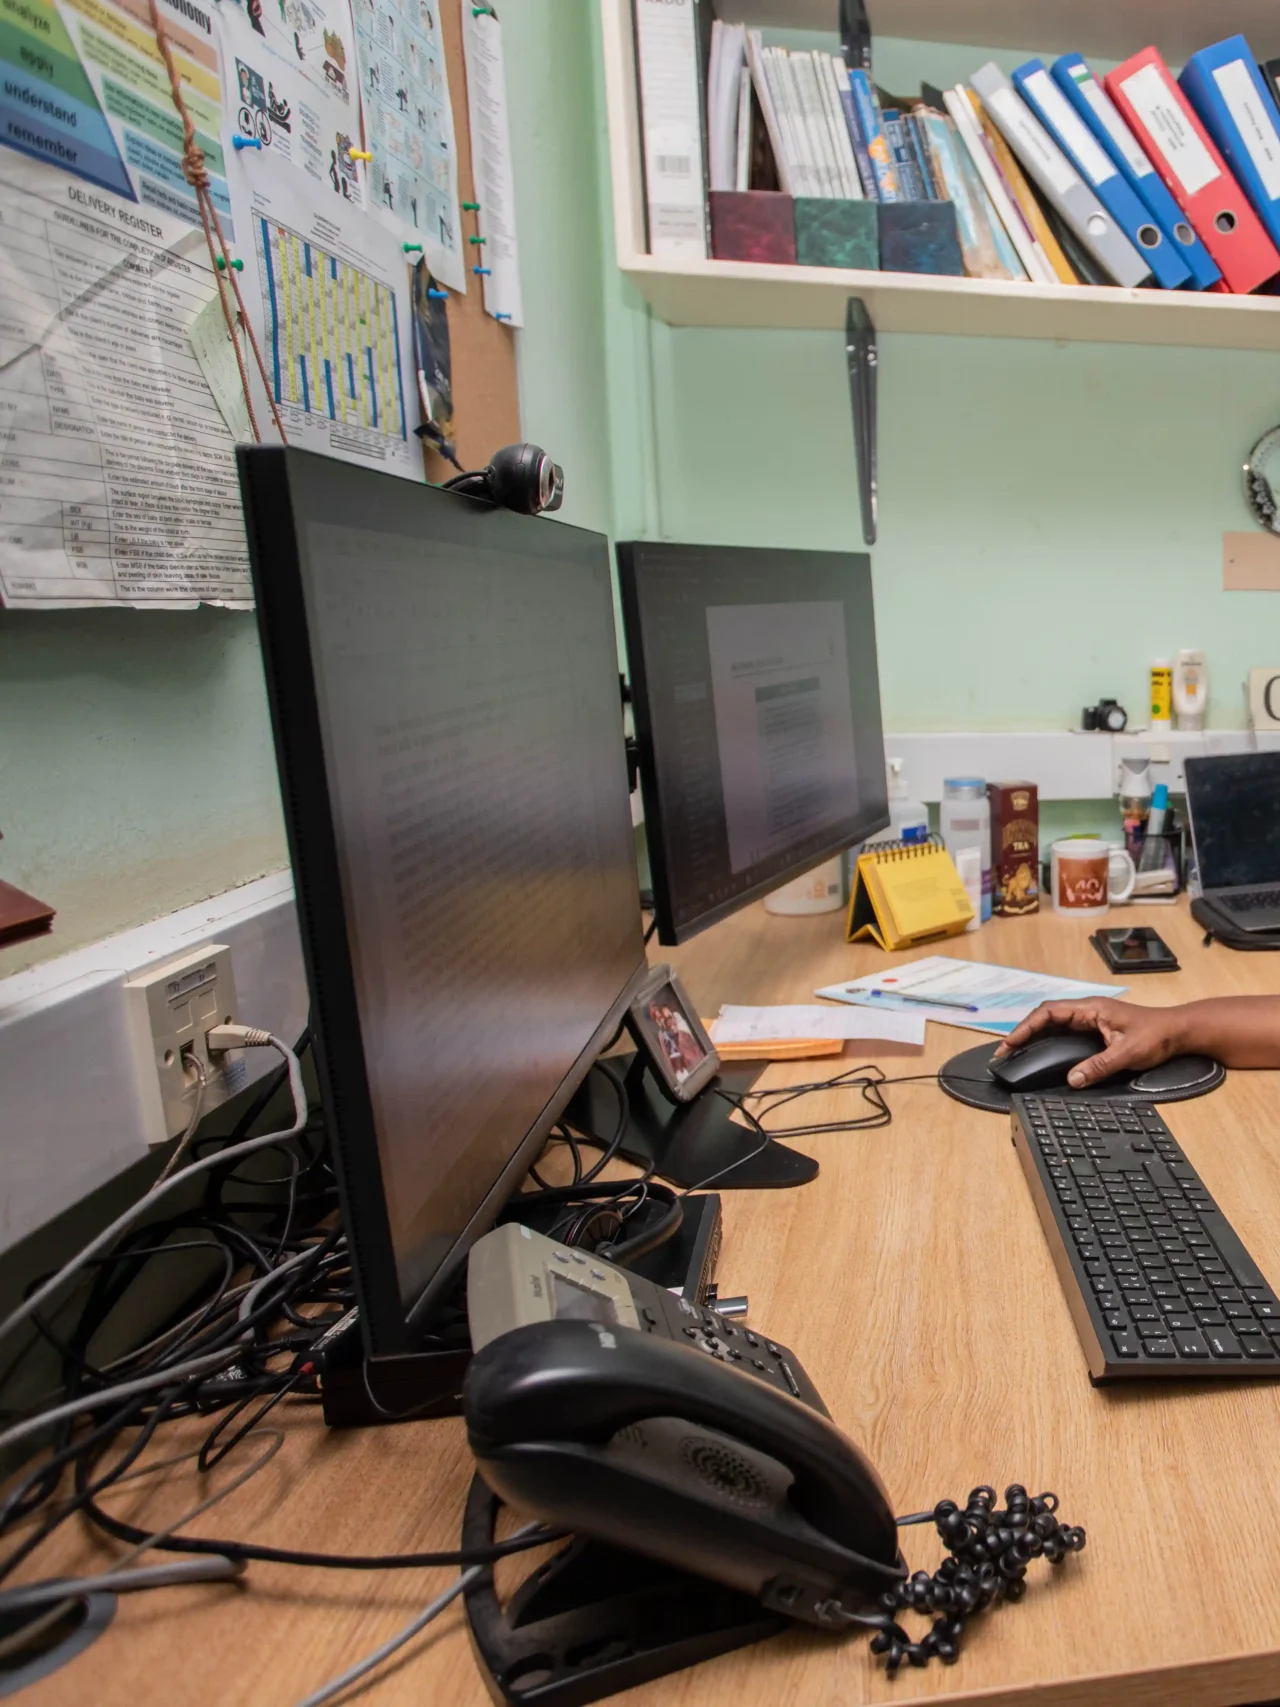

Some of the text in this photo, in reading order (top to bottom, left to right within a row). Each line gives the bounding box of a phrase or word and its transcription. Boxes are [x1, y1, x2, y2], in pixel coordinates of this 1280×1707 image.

[4, 79, 78, 128] understand
[7, 120, 78, 163] remember
[68, 186, 164, 240] DELIVERY REGISTER
[54, 210, 96, 236] GUIDELINES
[96, 227, 110, 239] FOR
[110, 232, 123, 246] THE
[166, 256, 192, 274] REGISTER
[122, 259, 154, 276] COMMENT
[156, 564, 168, 572] baby
[1012, 841, 1029, 851] TEA
